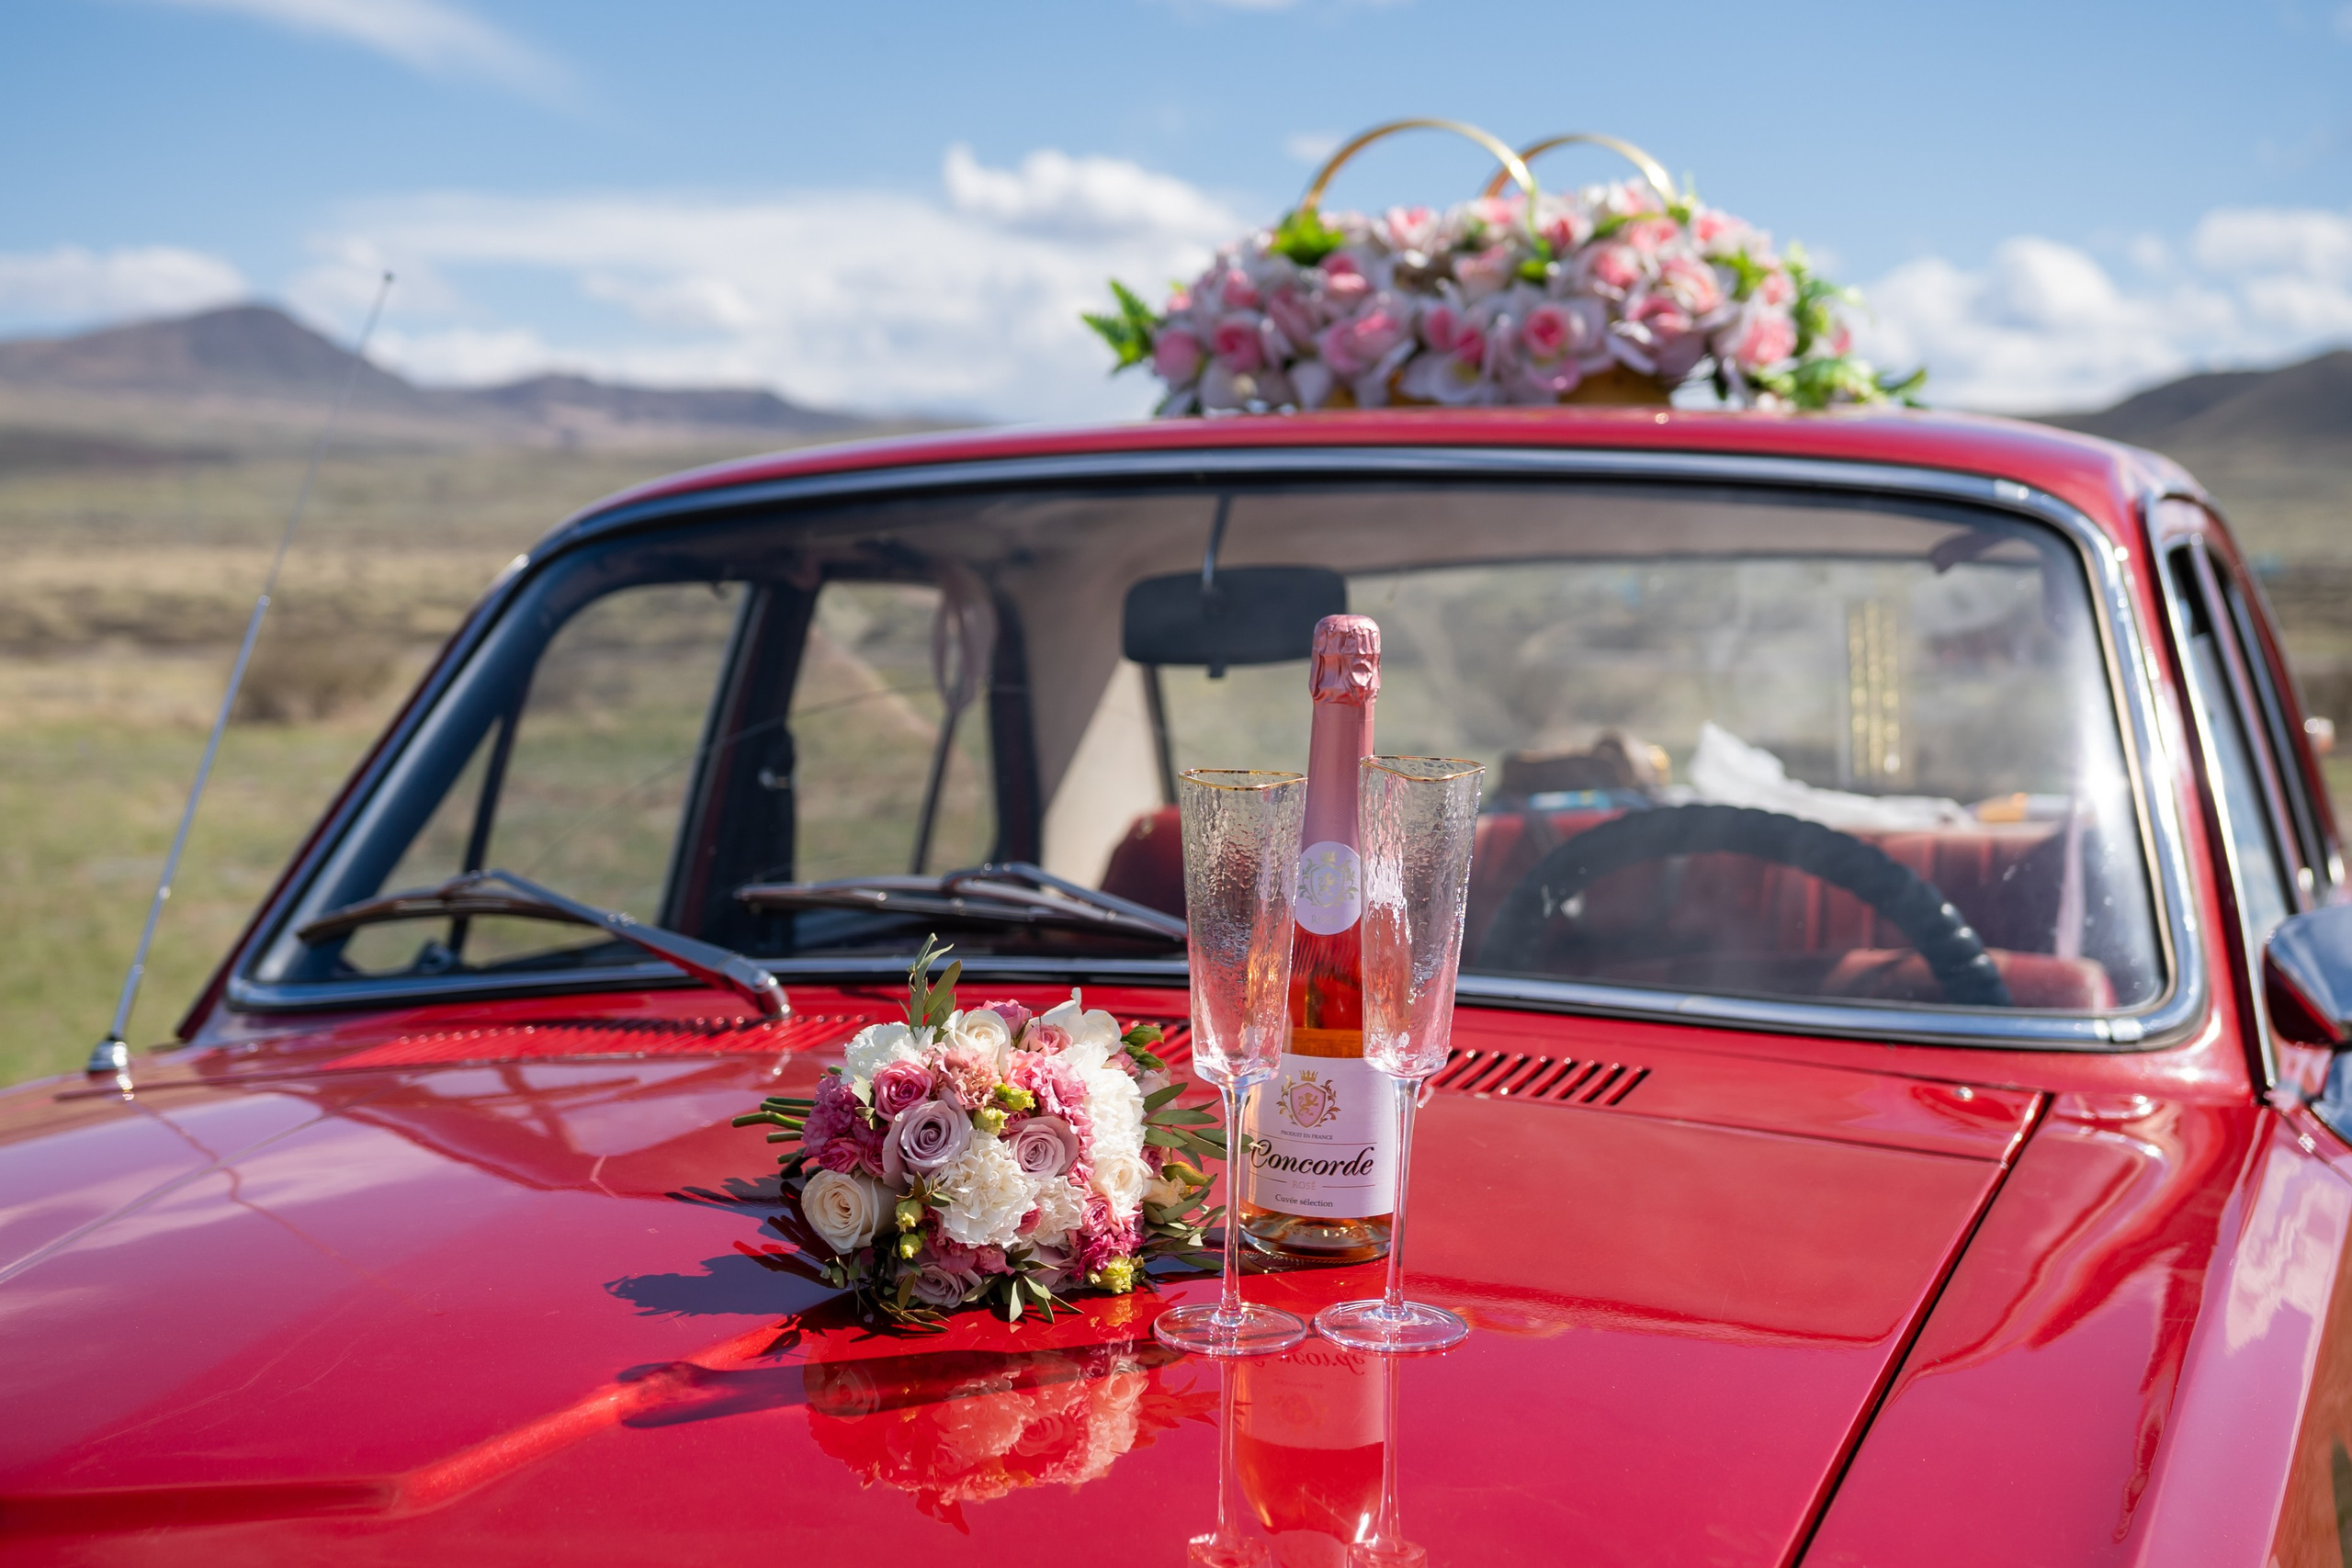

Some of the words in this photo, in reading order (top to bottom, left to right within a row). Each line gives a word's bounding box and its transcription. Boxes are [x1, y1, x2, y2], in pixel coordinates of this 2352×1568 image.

[1311, 915, 1338, 926] RO
[1281, 1130, 1302, 1138] PRODUIT
[1251, 1139, 1374, 1176] Concorde
[1292, 1180, 1317, 1190] ROSÉ
[1275, 1194, 1298, 1204] Cuvée
[1299, 1199, 1333, 1207] sélection
